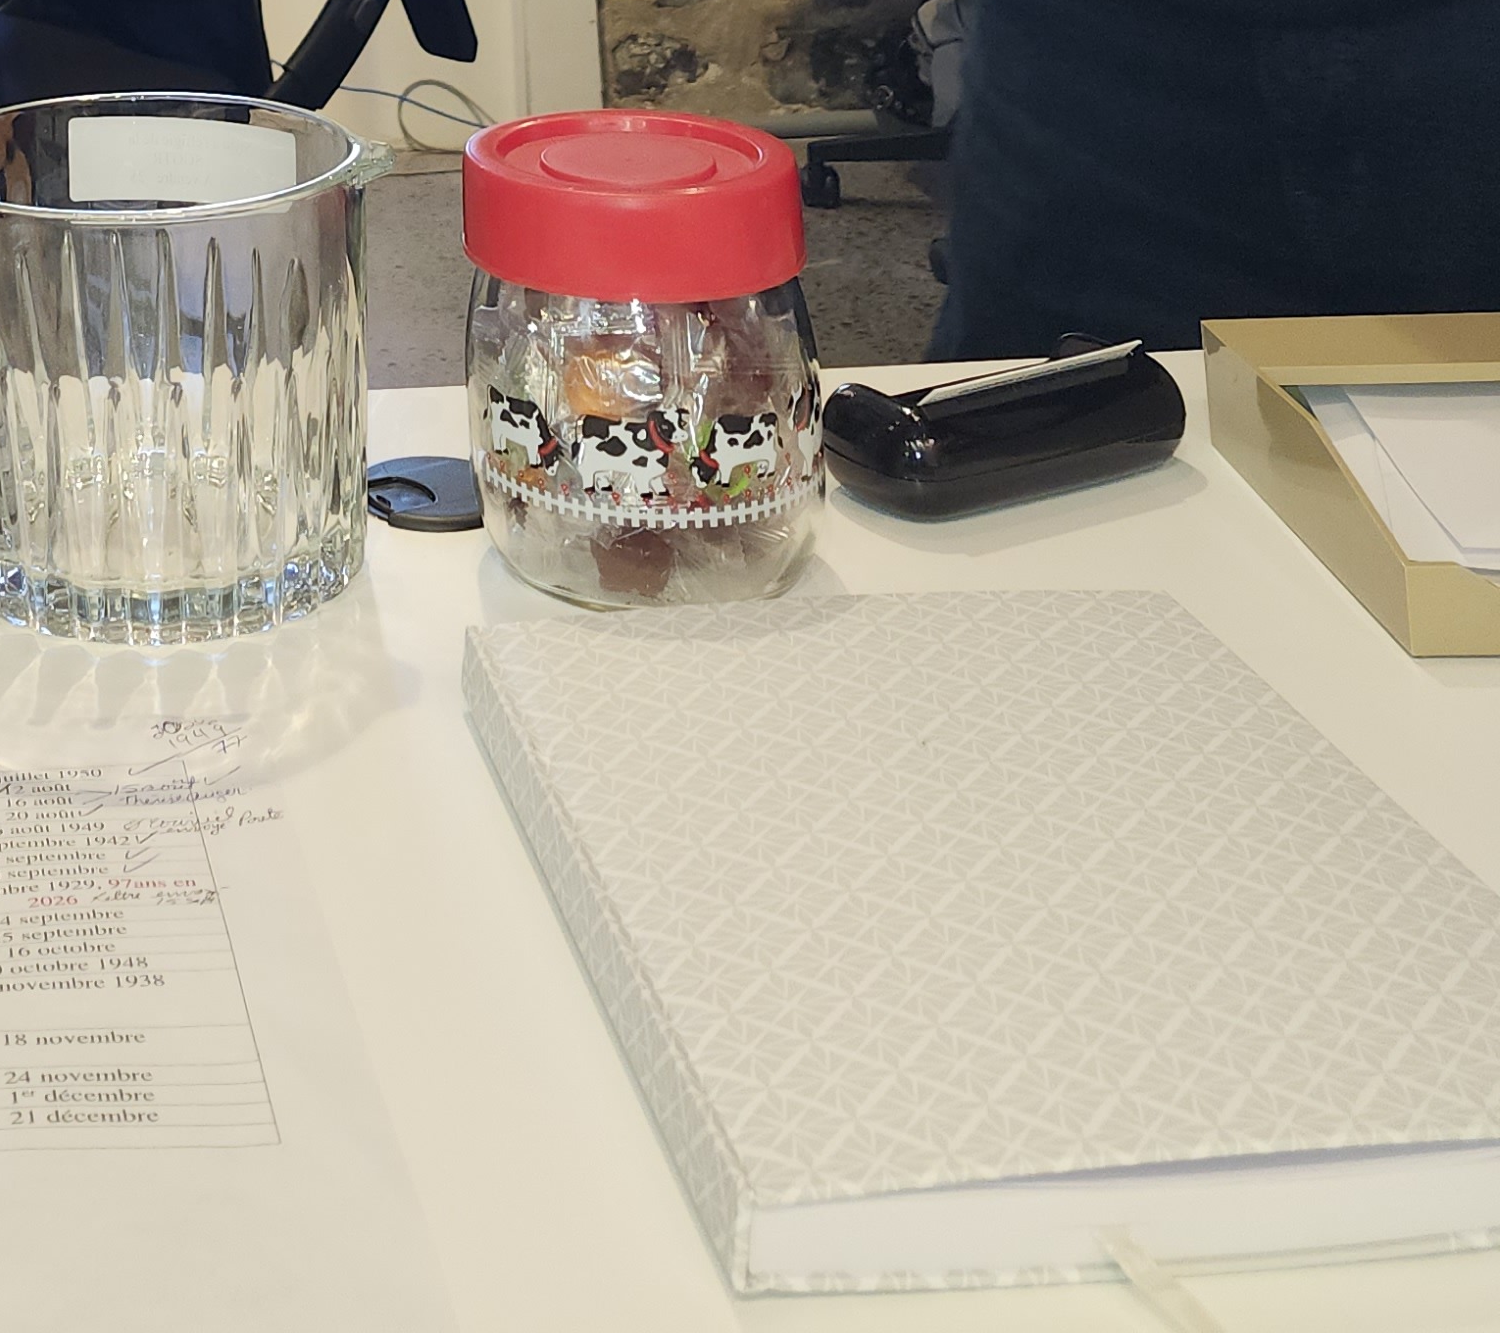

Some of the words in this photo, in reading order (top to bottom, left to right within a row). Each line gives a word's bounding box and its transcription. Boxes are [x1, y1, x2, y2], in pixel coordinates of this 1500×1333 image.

[59, 768, 103, 779] 1950
[32, 782, 71, 793] août
[33, 796, 73, 806] août
[60, 821, 105, 832] 1949
[85, 835, 131, 846] 1942
[6, 850, 106, 865] septembre
[7, 865, 109, 881] septembre
[28, 895, 79, 908] 2026
[19, 908, 125, 926] septembre
[21, 924, 127, 942] septembre
[7, 946, 31, 958] 16
[37, 941, 116, 956] octobre
[10, 961, 89, 974] octobre
[99, 956, 149, 970] 1948
[0, 976, 105, 992] novembre
[115, 974, 166, 988] 1938
[3, 1033, 27, 1046] 18
[35, 1031, 147, 1045] novembre
[4, 1071, 30, 1084] 24
[40, 1069, 153, 1083] novembre
[44, 1088, 155, 1103] décembre
[11, 1110, 36, 1125] 21
[46, 1109, 160, 1124] décembre
